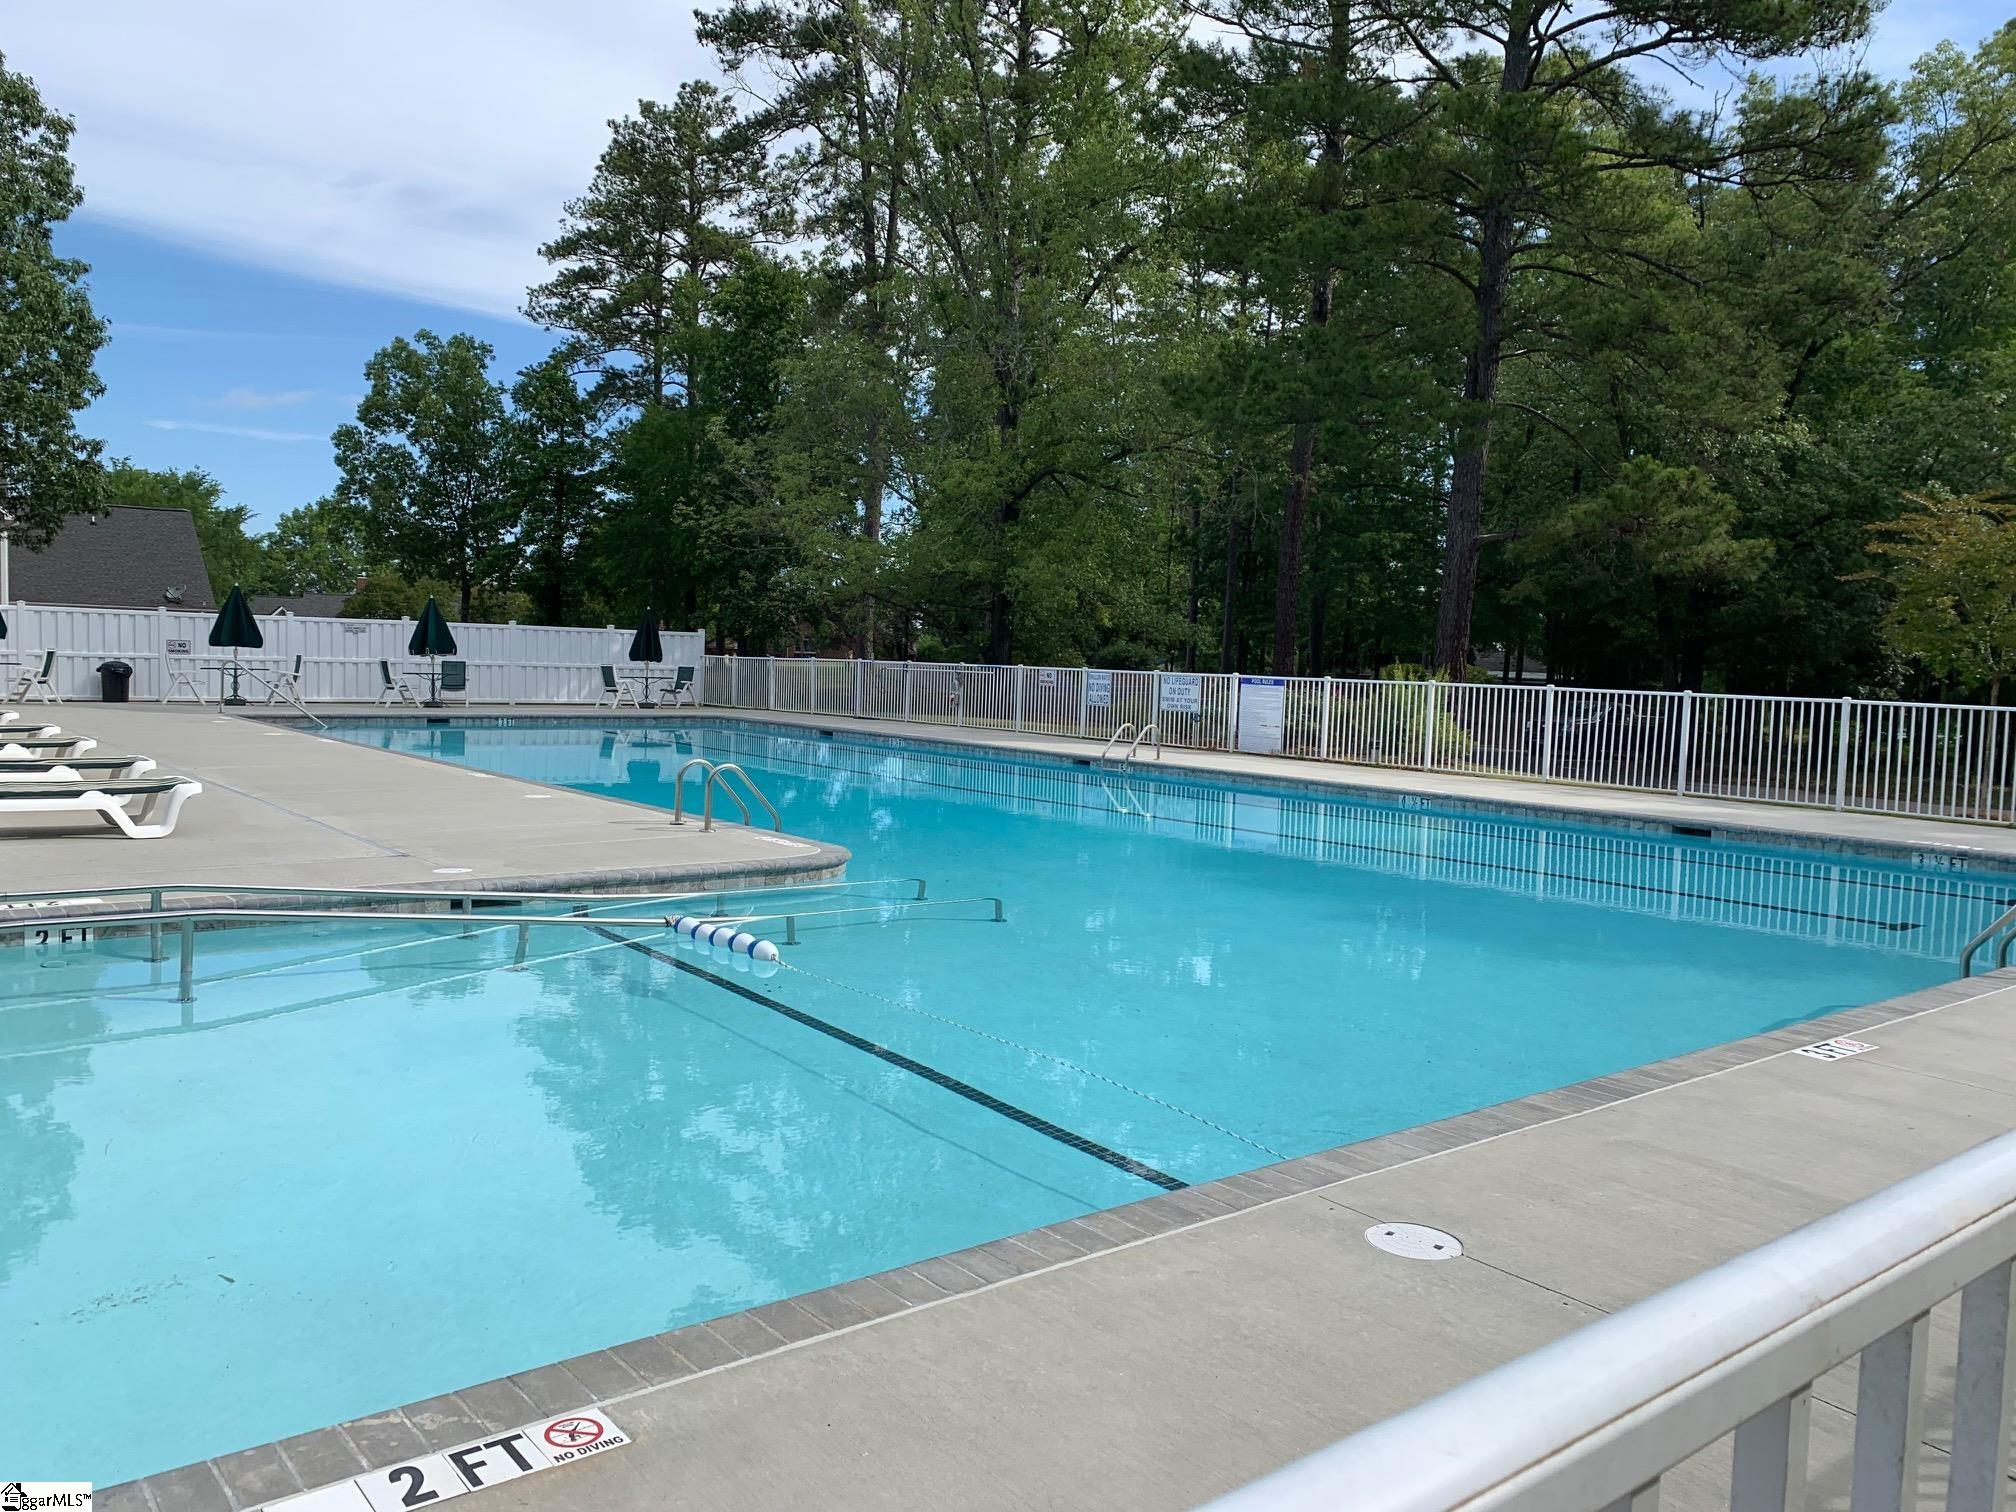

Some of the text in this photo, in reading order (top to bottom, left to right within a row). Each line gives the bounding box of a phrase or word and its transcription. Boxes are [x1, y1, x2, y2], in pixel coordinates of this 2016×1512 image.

[1163, 677, 1198, 686] NO LIFEGUARD
[1089, 682, 1110, 693] NO DIVING
[1169, 687, 1191, 696] ON DUTY
[1088, 694, 1109, 704] ALLOWED
[35, 926, 92, 945] 2 FT
[553, 1436, 624, 1463] NO DIVING
[388, 1433, 533, 1508] 2 FT
